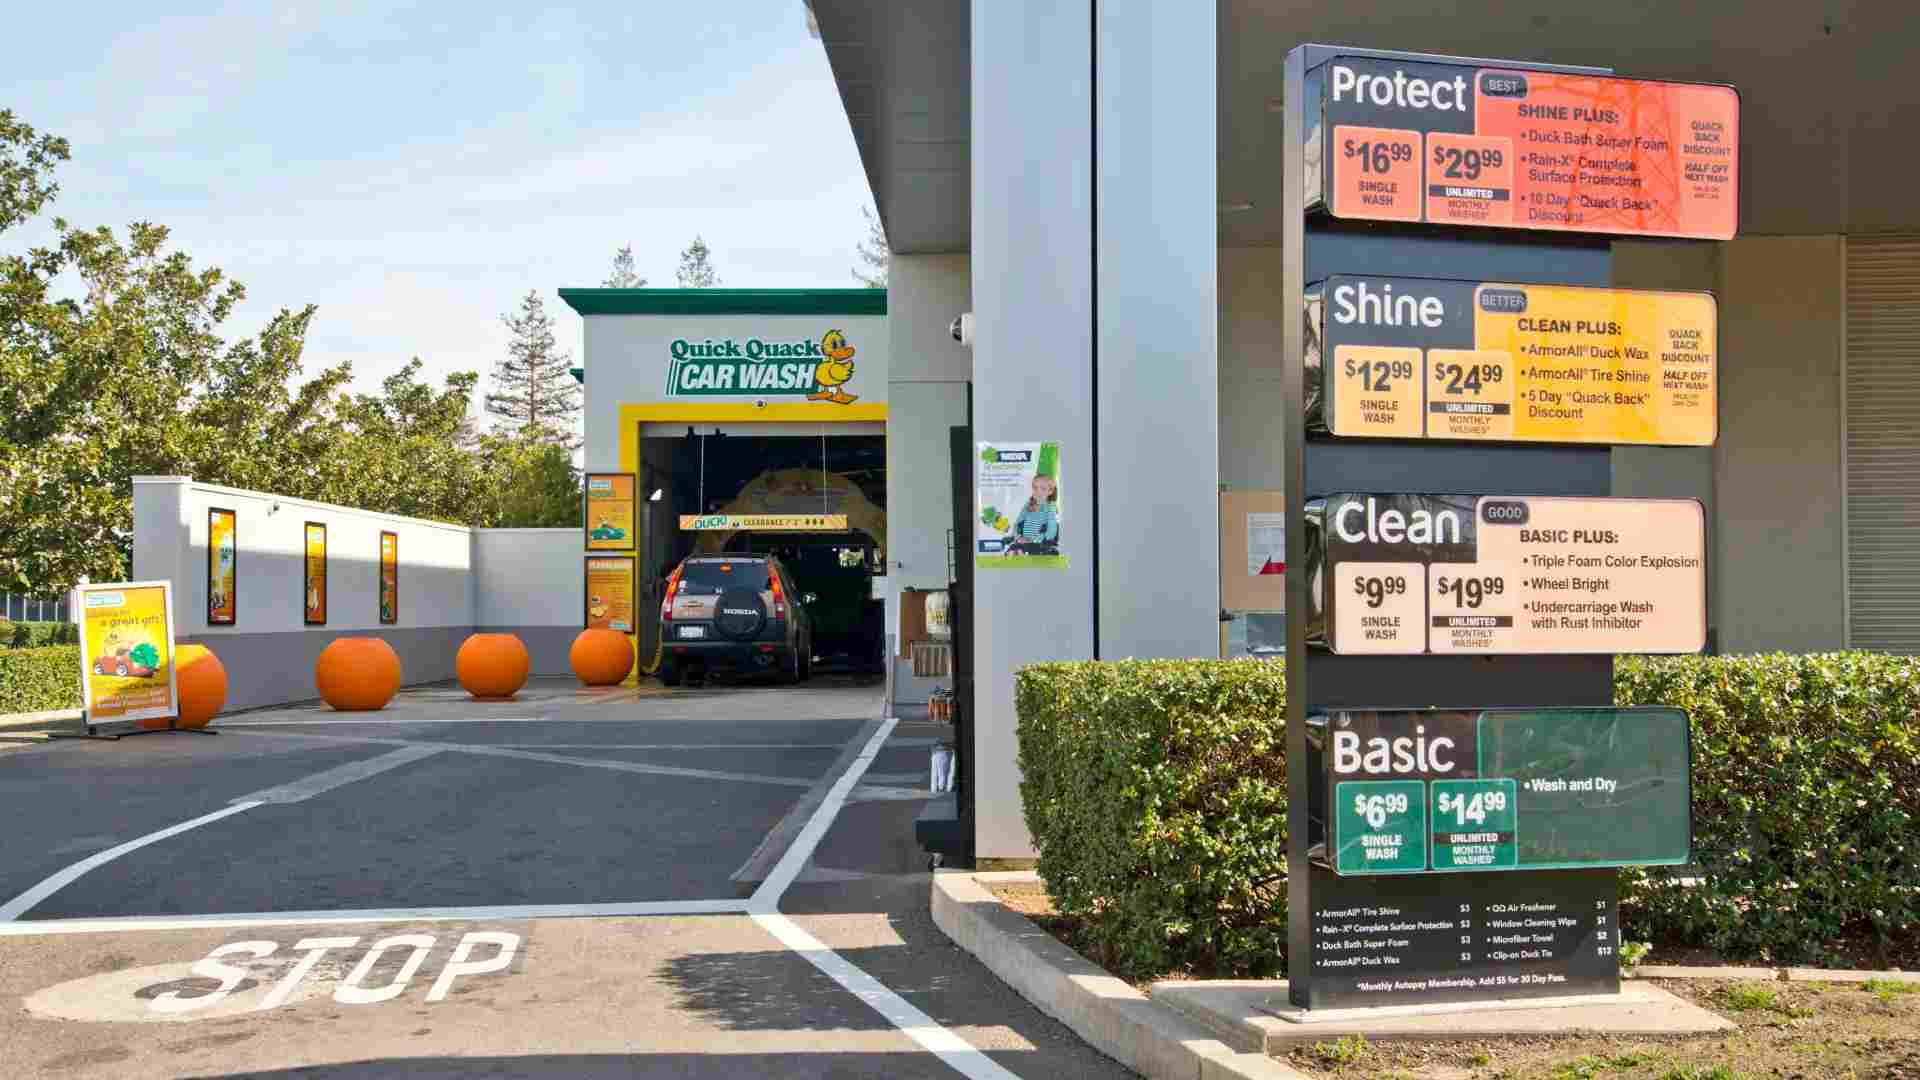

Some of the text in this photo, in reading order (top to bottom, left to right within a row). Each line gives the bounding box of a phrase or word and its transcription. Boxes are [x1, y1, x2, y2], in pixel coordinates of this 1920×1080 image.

[1332, 65, 1467, 112] Protect
[1488, 79, 1519, 93] BEST
[1518, 104, 1620, 124] SHINE PLUS:
[1528, 129, 1669, 151] Duck Bath Super Foam
[1684, 144, 1731, 156] DISCOUNT
[1578, 156, 1637, 172] Complete
[1685, 160, 1728, 173] HALF OFF
[1528, 169, 1642, 188] Surface Protection
[1360, 181, 1397, 194] SINGLE
[1446, 186, 1494, 199] UNLIMITED
[1363, 194, 1393, 207] WASH
[1448, 199, 1489, 209] MONTHLY
[1530, 192, 1544, 203] 10
[1546, 193, 1569, 208] Day
[1528, 207, 1584, 222] Discount
[1334, 282, 1444, 328] Shine
[1482, 294, 1525, 307] BETTER
[1518, 318, 1621, 336] CLEAN PLUS:
[1669, 329, 1701, 338] QUACK
[670, 339, 820, 361] Quick Quack
[1673, 340, 1698, 350] BACK
[1591, 346, 1621, 359] Duck
[1624, 348, 1649, 361] Wax
[1662, 352, 1710, 362] DISCOUNT
[680, 364, 817, 389] CAR WASH
[1591, 369, 1613, 382] Tire
[1616, 371, 1650, 383] Shine
[1664, 368, 1708, 380] HALF OFF
[1528, 391, 1535, 402] 5
[1537, 391, 1561, 406] Day
[1360, 400, 1398, 411] SINGLE
[1446, 402, 1494, 414] UNLIMITED
[1363, 413, 1395, 425] WASH
[1528, 406, 1583, 419] Discount
[1449, 416, 1491, 425] MONTHLY
[1488, 506, 1522, 519] GOOD
[1335, 497, 1460, 543] Clean
[1519, 530, 1618, 544] BASIC PLUS:
[1532, 555, 1699, 570] Triple Foam Color Explosion
[1532, 578, 1609, 593] Wheel Bright
[723, 608, 759, 616] HONDA
[1532, 601, 1654, 616] Undercarriage Wash
[1361, 617, 1400, 627] SINGLE
[1448, 617, 1497, 627] UNLIMITED
[1532, 617, 1642, 630] with Rust Inhibitor
[1365, 629, 1397, 640] WASH
[1451, 629, 1494, 638] MONTHLY
[1334, 725, 1455, 773] Basic
[1532, 778, 1617, 793] Wash and Dry
[1362, 835, 1402, 846] SINGLE
[1450, 832, 1498, 843] UNLIMITED
[1366, 848, 1399, 859] WASH
[1453, 845, 1495, 855] MONTHLY
[1362, 908, 1377, 916] Tire
[1379, 907, 1400, 916] Shine
[1508, 904, 1519, 912] Air
[1520, 902, 1556, 912] Freshener
[1353, 923, 1388, 933] Complete
[1390, 922, 1416, 931] Surface
[1417, 921, 1454, 930] Protection
[1492, 919, 1523, 929] Window
[1524, 918, 1557, 929] Cleaning
[1322, 941, 1342, 950] Duck
[1344, 941, 1362, 949] Bath
[1364, 939, 1386, 950] Super
[1388, 938, 1409, 947] Foam
[1532, 933, 1554, 942] Towel
[1362, 956, 1381, 965] Duck
[1383, 956, 1400, 964] Wax
[1492, 951, 1519, 961] Clip-on
[1520, 949, 1540, 959] Duck
[150, 931, 520, 1012] STOP
[1394, 980, 1426, 991] Autopay
[1479, 977, 1495, 985] Add
[1508, 975, 1519, 984] for
[1520, 975, 1531, 983] 30
[1531, 974, 1546, 984] Day
